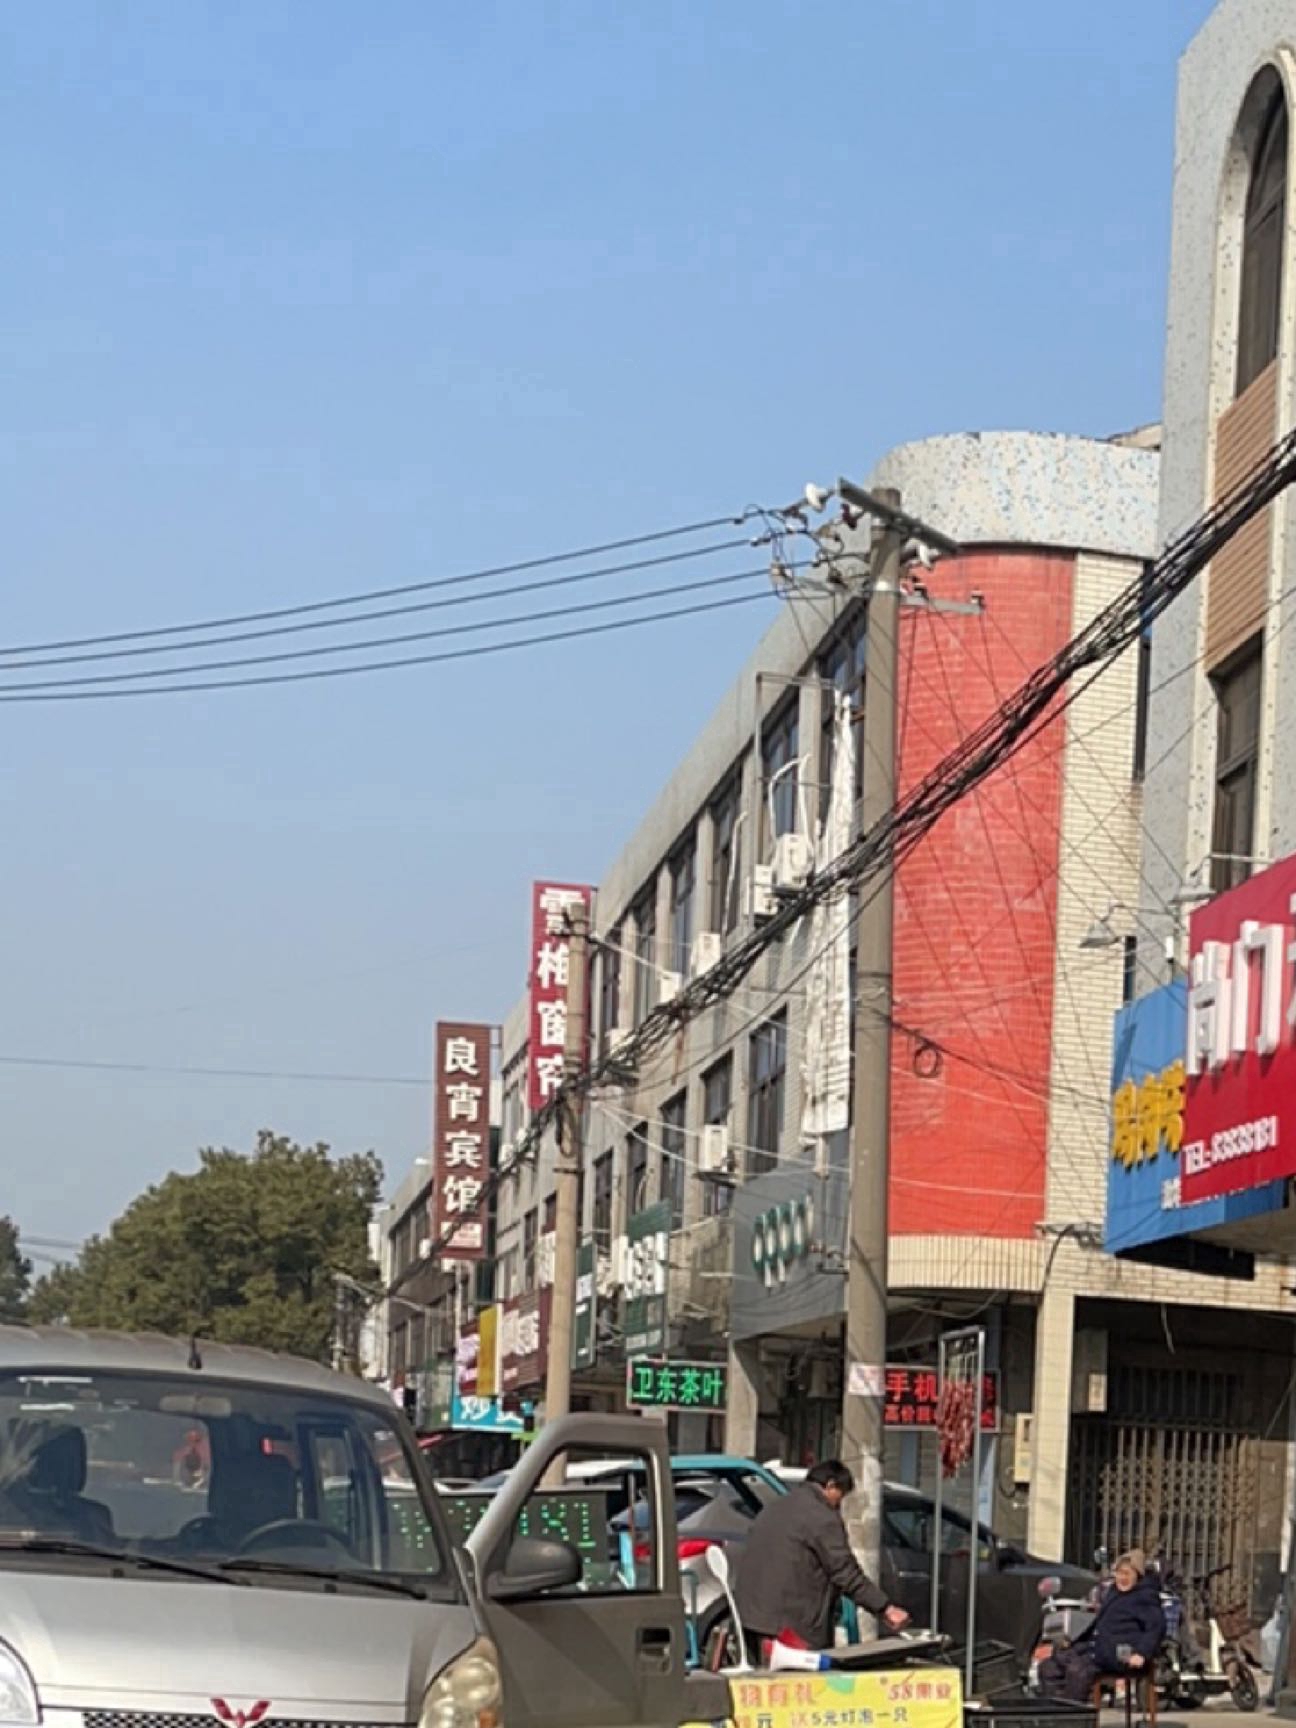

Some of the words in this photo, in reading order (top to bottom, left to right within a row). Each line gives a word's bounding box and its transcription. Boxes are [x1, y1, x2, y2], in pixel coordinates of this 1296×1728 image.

[441, 1036, 483, 1214] 良宵宾馆
[632, 1366, 724, 1405] 卫东茶叶
